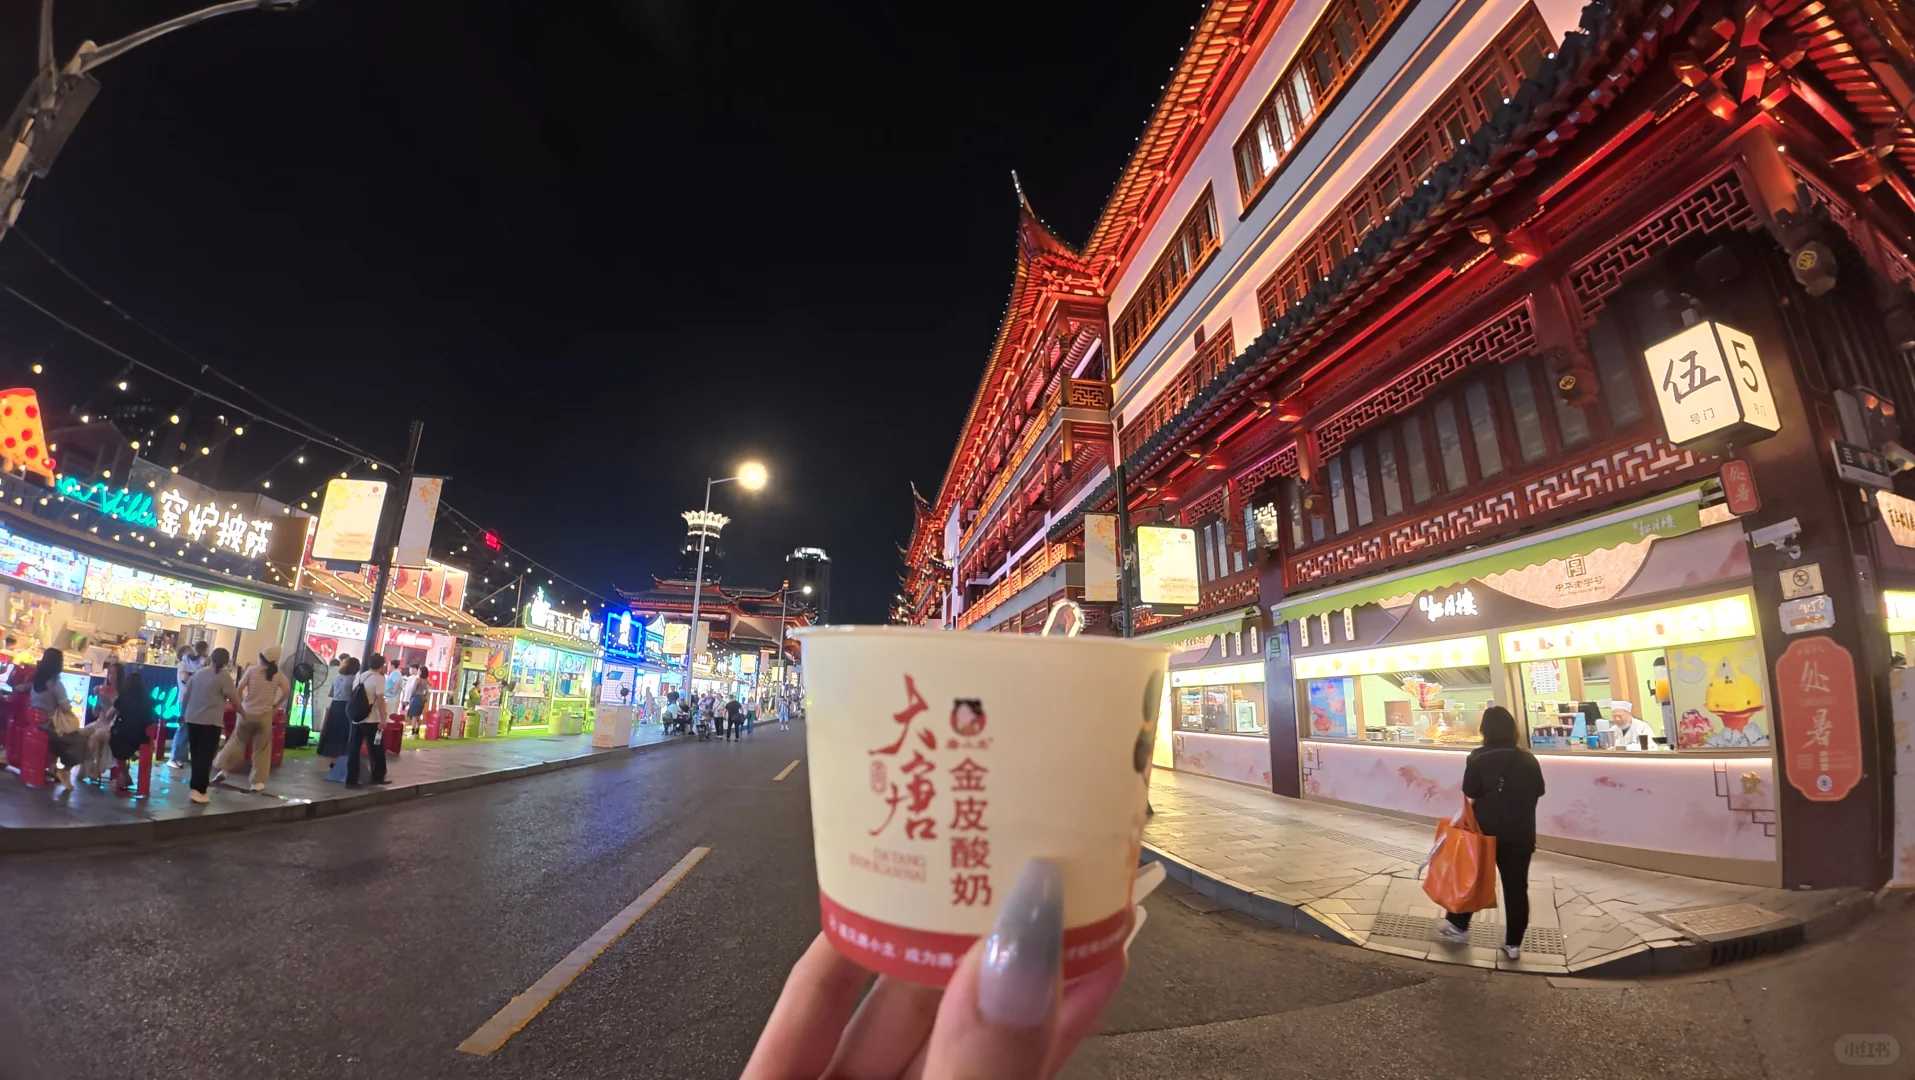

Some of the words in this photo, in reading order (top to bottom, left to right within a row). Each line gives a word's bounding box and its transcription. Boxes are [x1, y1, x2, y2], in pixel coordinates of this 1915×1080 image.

[1663, 350, 1721, 404] 伍
[1731, 340, 1759, 393] 5
[1689, 407, 1716, 425] 号门
[949, 757, 993, 907] 金皮酸奶
